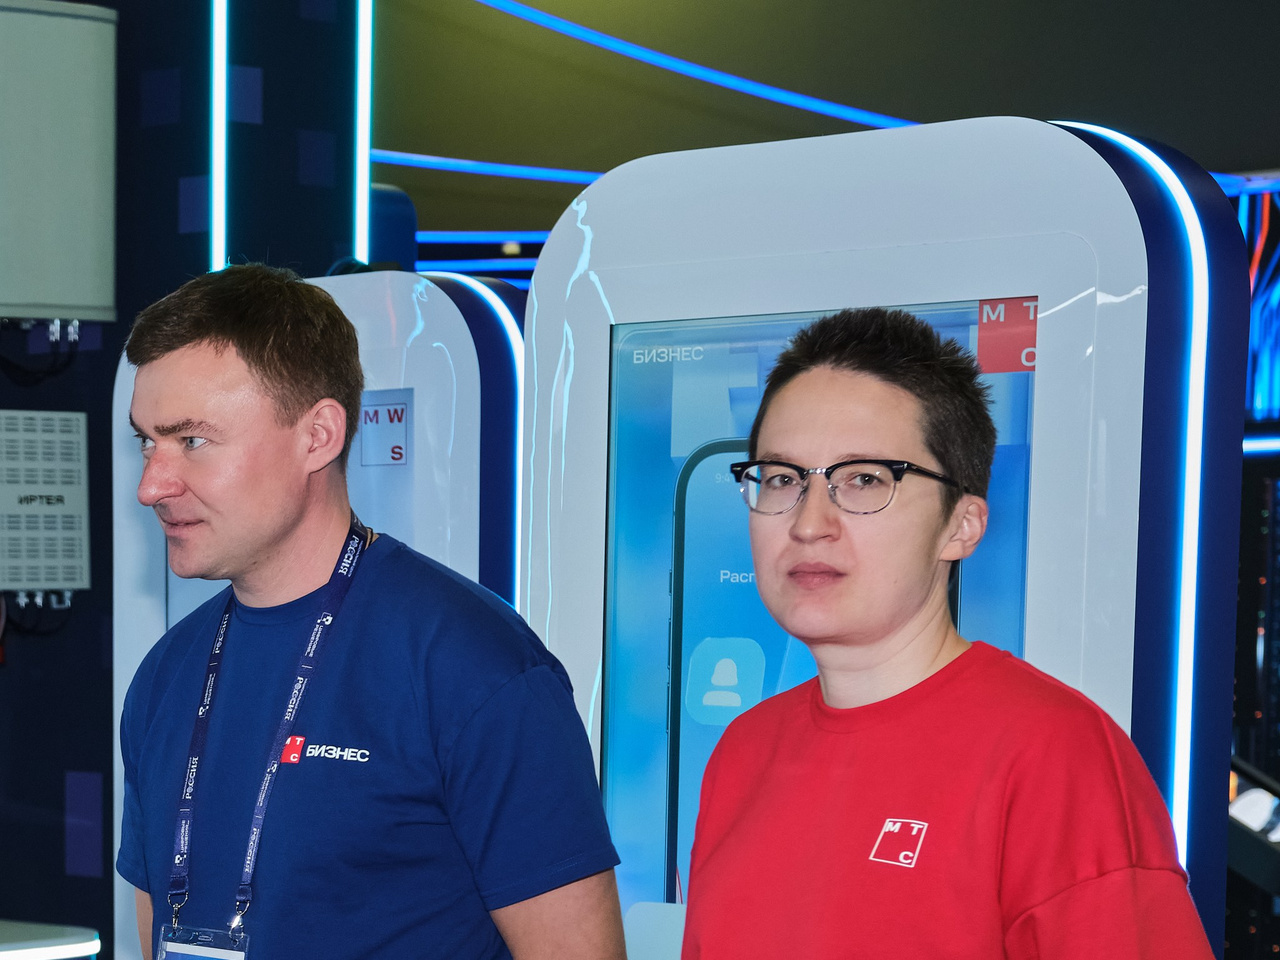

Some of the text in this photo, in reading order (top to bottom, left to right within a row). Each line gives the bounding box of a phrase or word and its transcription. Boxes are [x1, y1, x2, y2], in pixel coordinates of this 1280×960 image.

[633, 347, 704, 364] БИЗНЕС
[338, 535, 360, 576] РОССИЯ
[284, 676, 304, 720] РОССИЯ
[306, 744, 370, 762] БИЗНЕС
[186, 756, 199, 800] РОССИЯ
